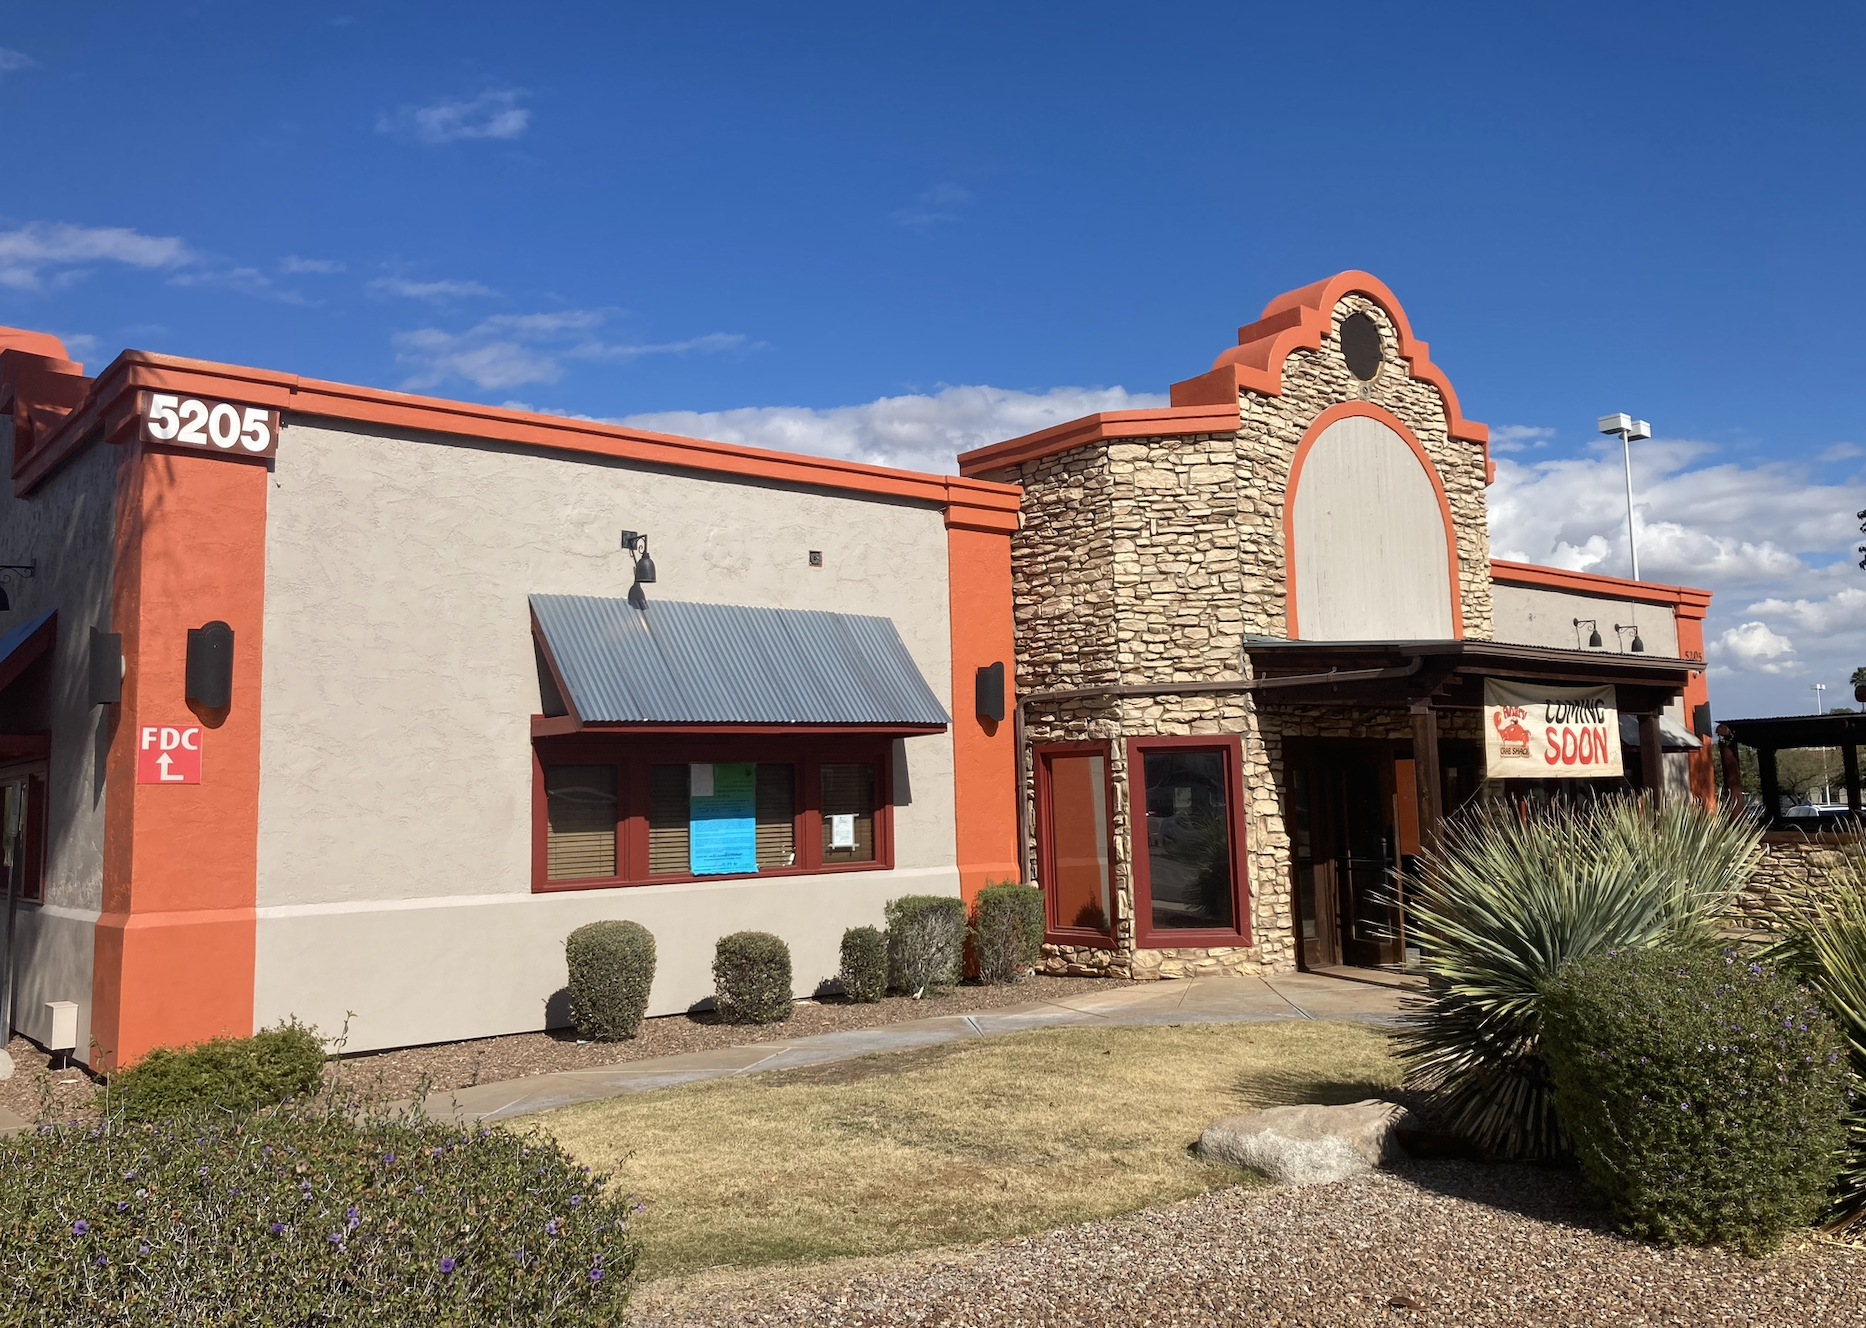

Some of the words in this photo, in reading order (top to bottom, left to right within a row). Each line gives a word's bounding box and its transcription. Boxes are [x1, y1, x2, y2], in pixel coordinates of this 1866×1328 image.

[148, 394, 270, 452] 5205
[1545, 699, 1604, 724] COMING
[142, 727, 199, 750] FDC
[1544, 726, 1608, 765] SOON
